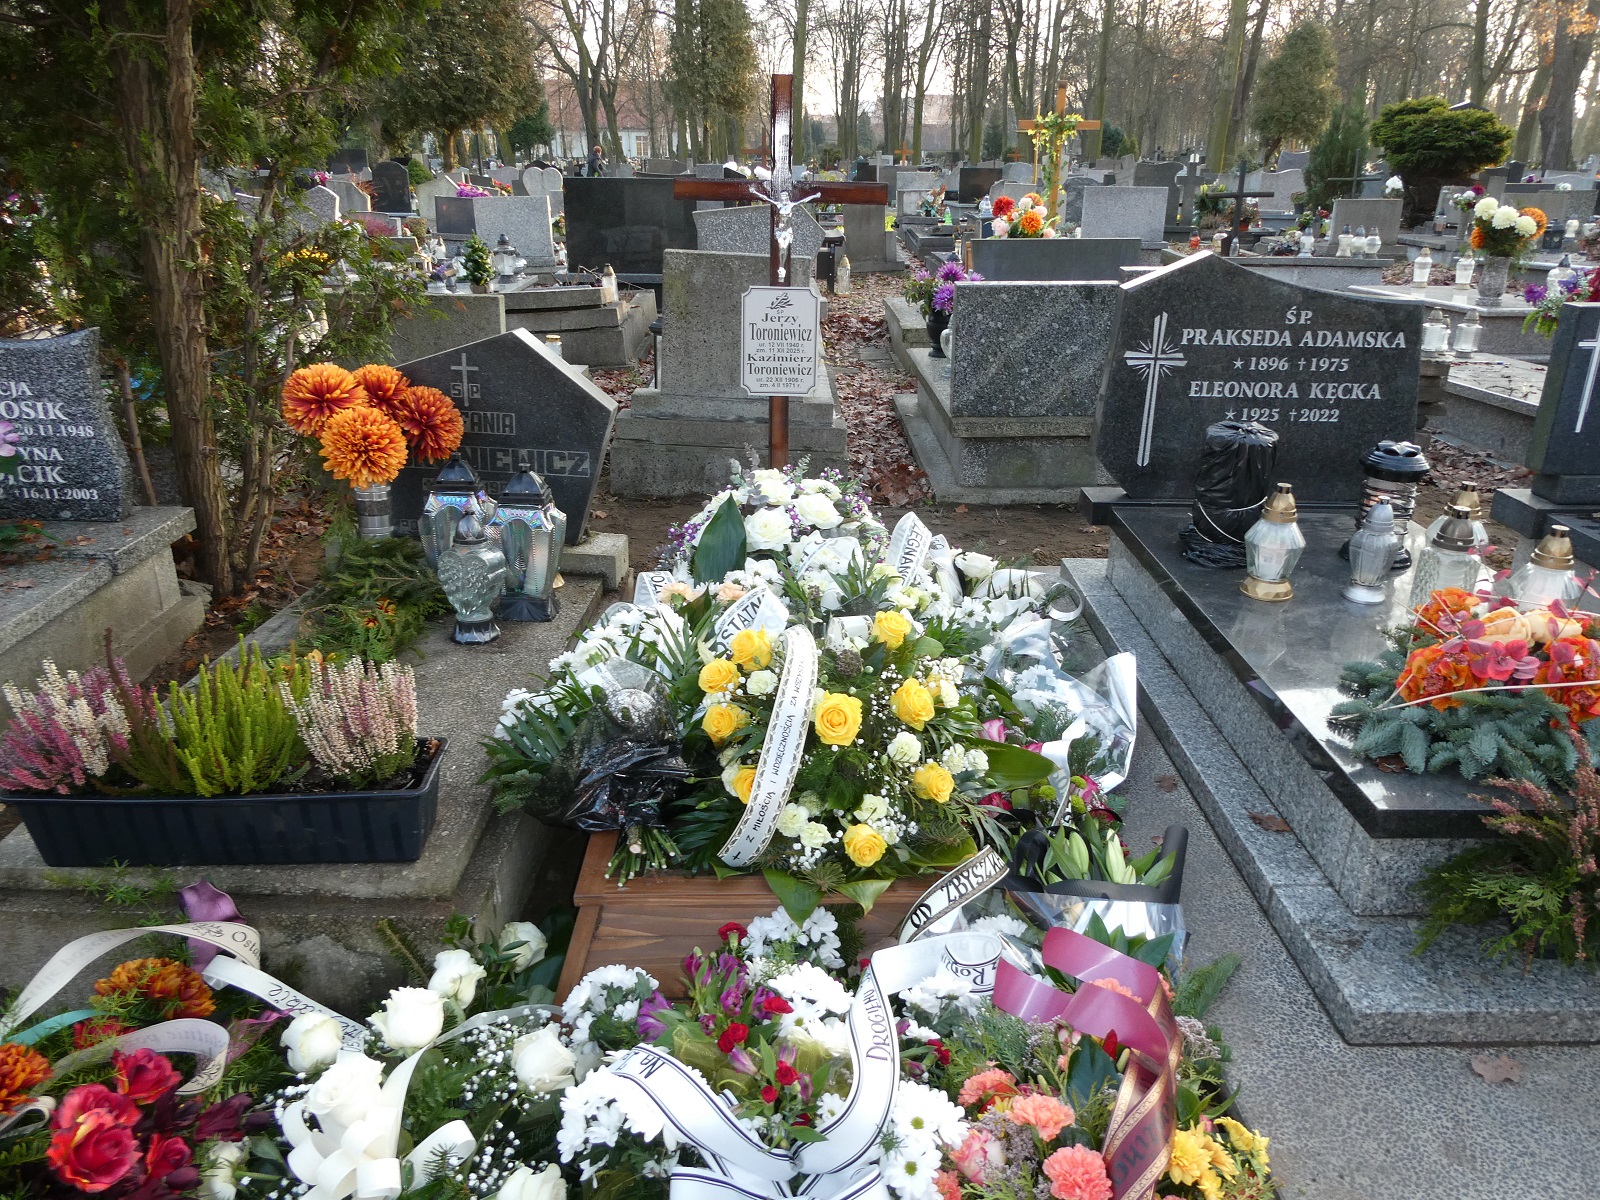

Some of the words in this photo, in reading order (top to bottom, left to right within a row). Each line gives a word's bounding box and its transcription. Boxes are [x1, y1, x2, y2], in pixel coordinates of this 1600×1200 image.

[761, 313, 799, 325] Jerzy
[748, 322, 813, 342] Toroniewicz
[1180, 328, 1292, 347] PRAKSEDA
[1298, 330, 1407, 349] ADAMSKA
[747, 353, 813, 363] Kazimierz
[746, 362, 813, 376] Toroniewicz
[1188, 380, 1299, 400] ELEONORA
[1309, 382, 1382, 404] KĘCKA
[910, 902, 932, 929] OD
